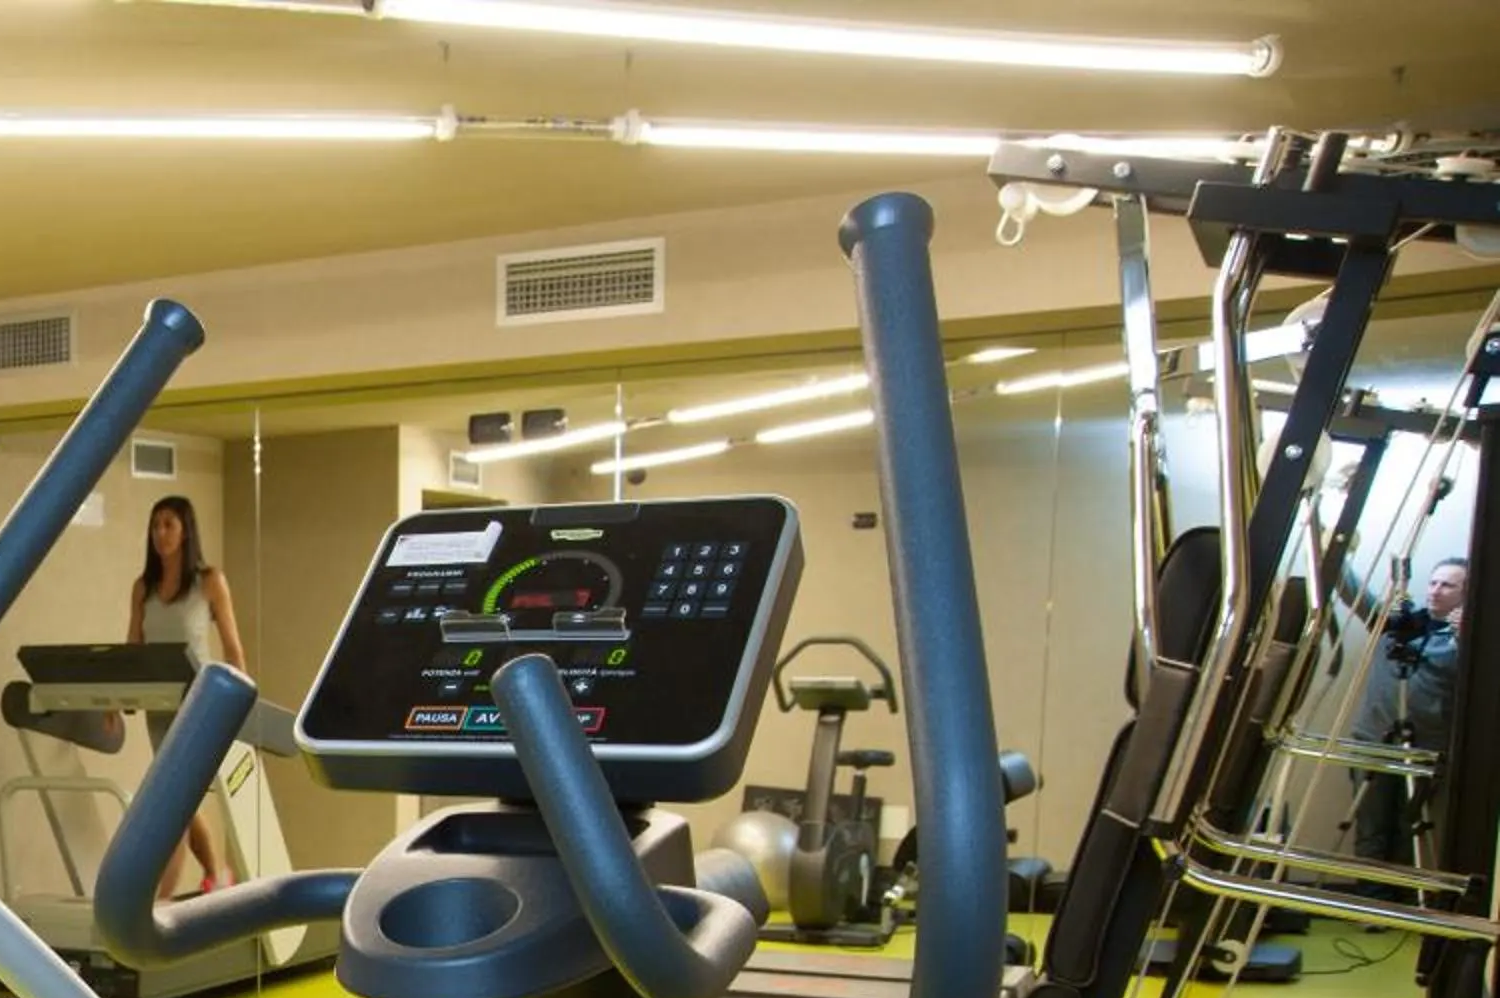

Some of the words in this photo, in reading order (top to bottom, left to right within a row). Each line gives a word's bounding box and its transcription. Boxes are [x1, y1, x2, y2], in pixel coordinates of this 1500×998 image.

[674, 547, 681, 557] 1
[700, 545, 712, 556] 2
[729, 545, 740, 556] 3
[663, 565, 675, 576] 4
[693, 565, 705, 576] 5
[723, 563, 734, 575] 6
[658, 584, 669, 595] 7
[686, 583, 698, 595] 8
[716, 583, 728, 595] 9
[680, 603, 691, 615] 0
[415, 712, 458, 724] PAUSA
[474, 711, 501, 724] AV
